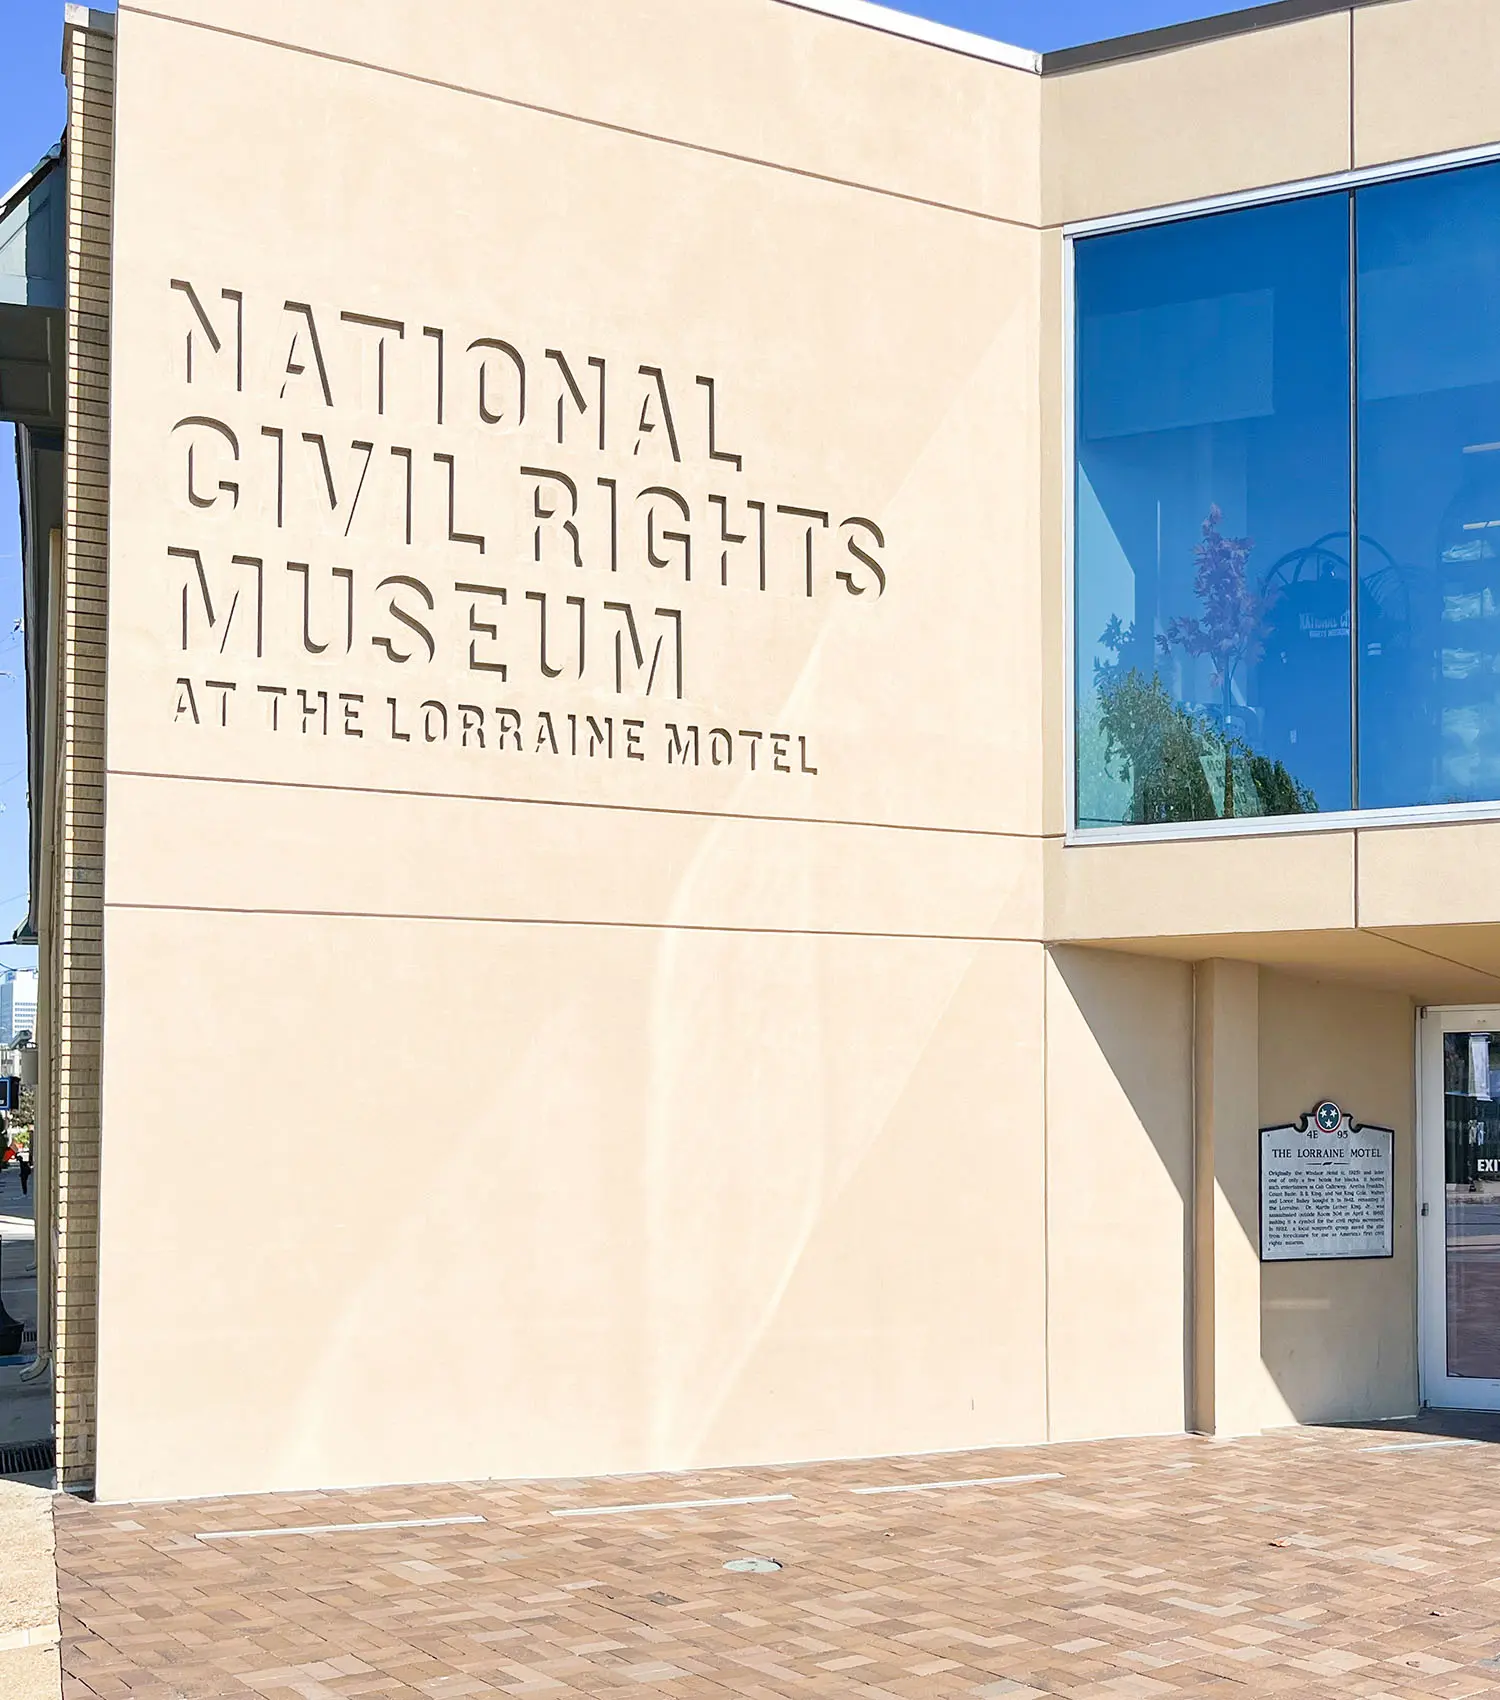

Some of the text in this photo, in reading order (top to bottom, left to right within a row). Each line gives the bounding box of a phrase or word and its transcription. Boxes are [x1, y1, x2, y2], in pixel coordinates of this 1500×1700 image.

[170, 278, 743, 471] NATIONAL
[171, 415, 887, 600] CIVIL RIGHTS
[167, 546, 684, 700] MUSEUM
[174, 677, 818, 776] AT THE LORRAINE MOTEL
[1272, 1148, 1382, 1158] THE LORRAINE MOTEL
[1306, 1130, 1348, 1139] 4E 95
[1478, 1159, 1500, 1171] EXI
